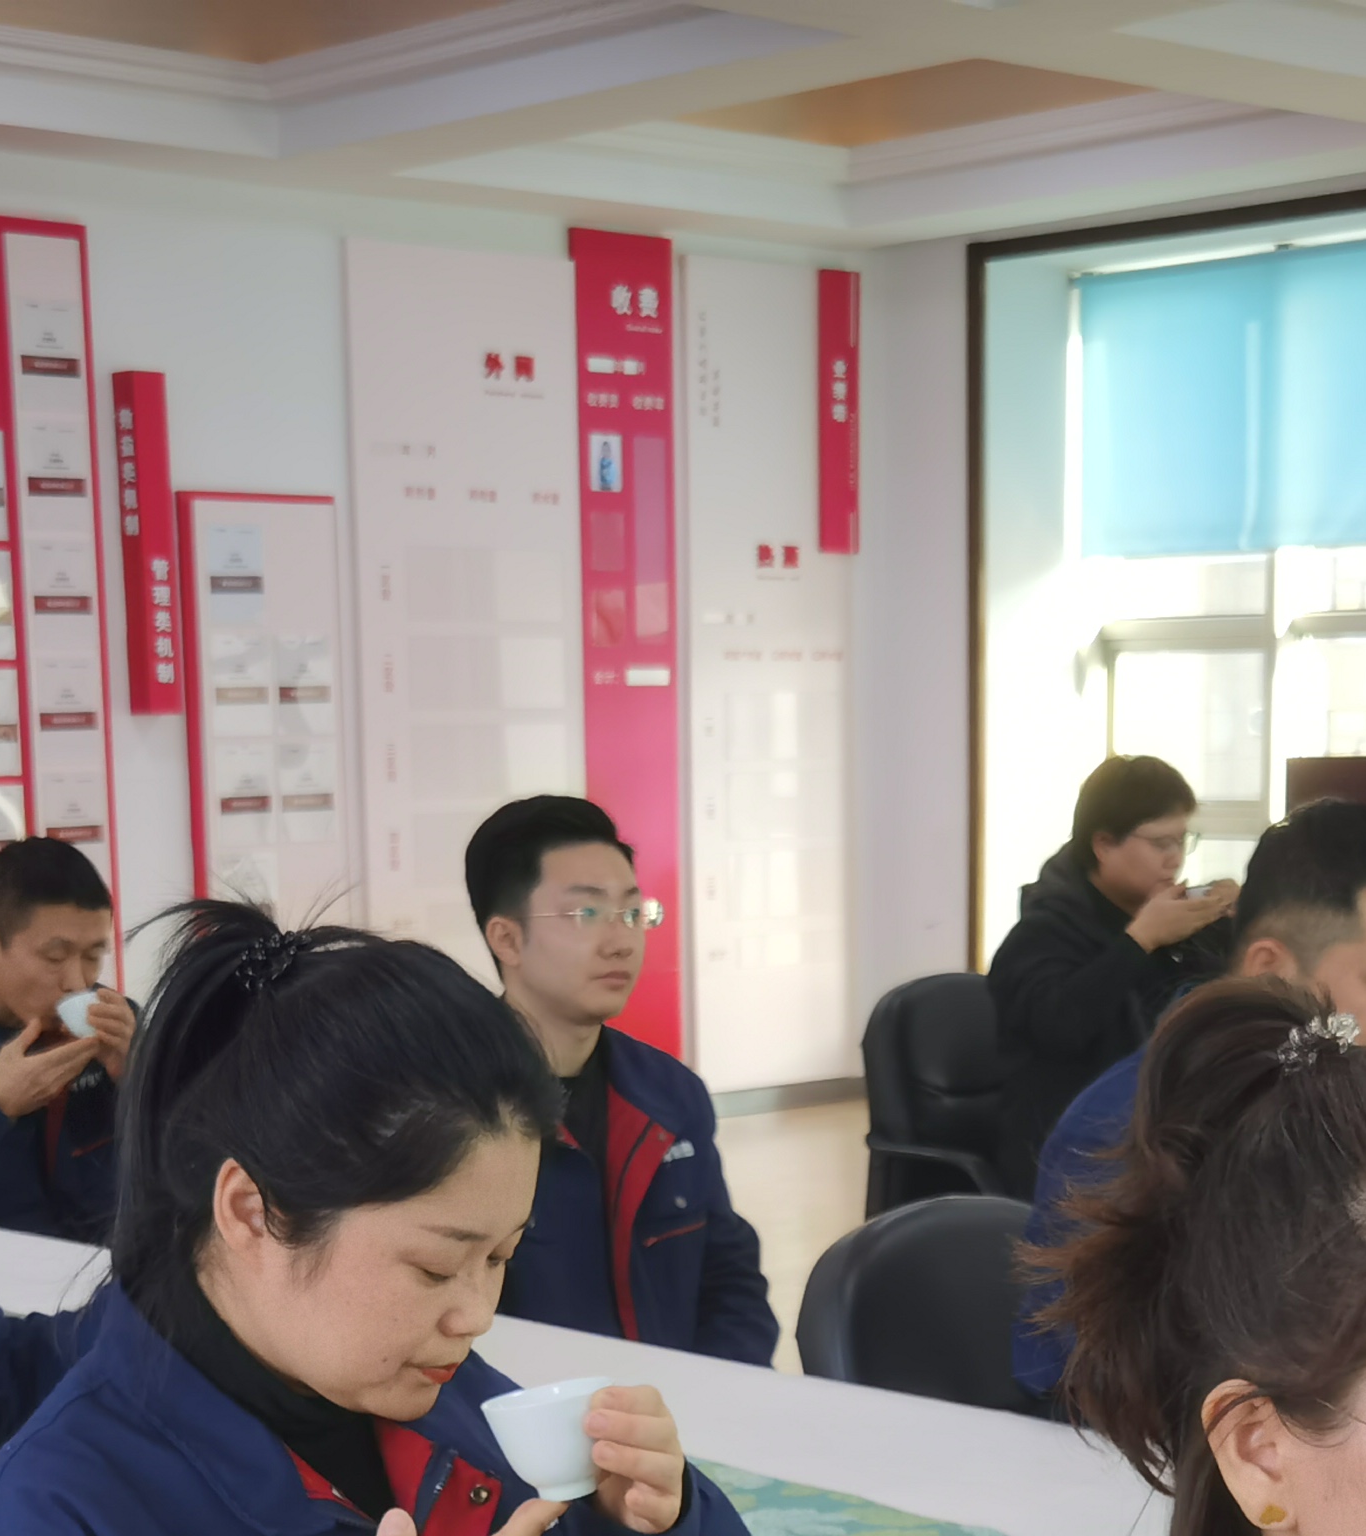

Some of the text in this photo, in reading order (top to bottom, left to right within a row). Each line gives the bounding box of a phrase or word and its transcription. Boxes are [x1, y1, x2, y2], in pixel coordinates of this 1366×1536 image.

[150, 558, 176, 685] 管理类机制
